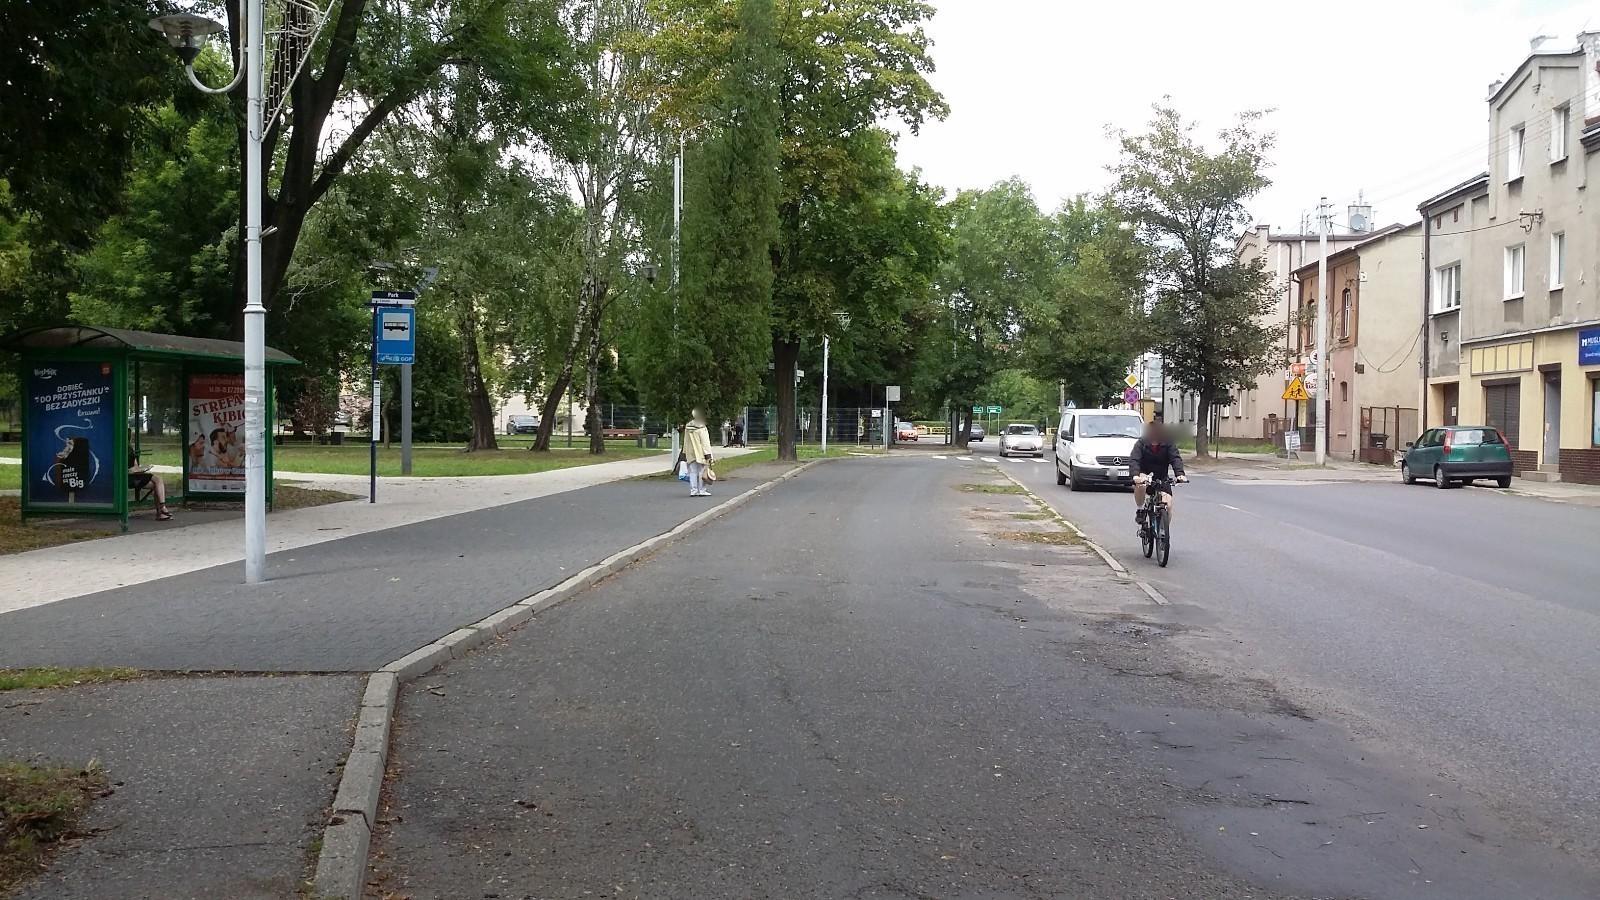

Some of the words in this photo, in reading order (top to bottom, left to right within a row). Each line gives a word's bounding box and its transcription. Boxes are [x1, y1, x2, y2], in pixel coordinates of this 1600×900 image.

[40, 395, 52, 404] DO
[52, 387, 104, 402] PRZYSTANKU
[57, 383, 83, 393] DOBIEC
[45, 402, 60, 412] BEZ
[61, 396, 100, 409] ZADYSZKI
[192, 394, 242, 416] STREFA
[69, 477, 84, 488] Big
